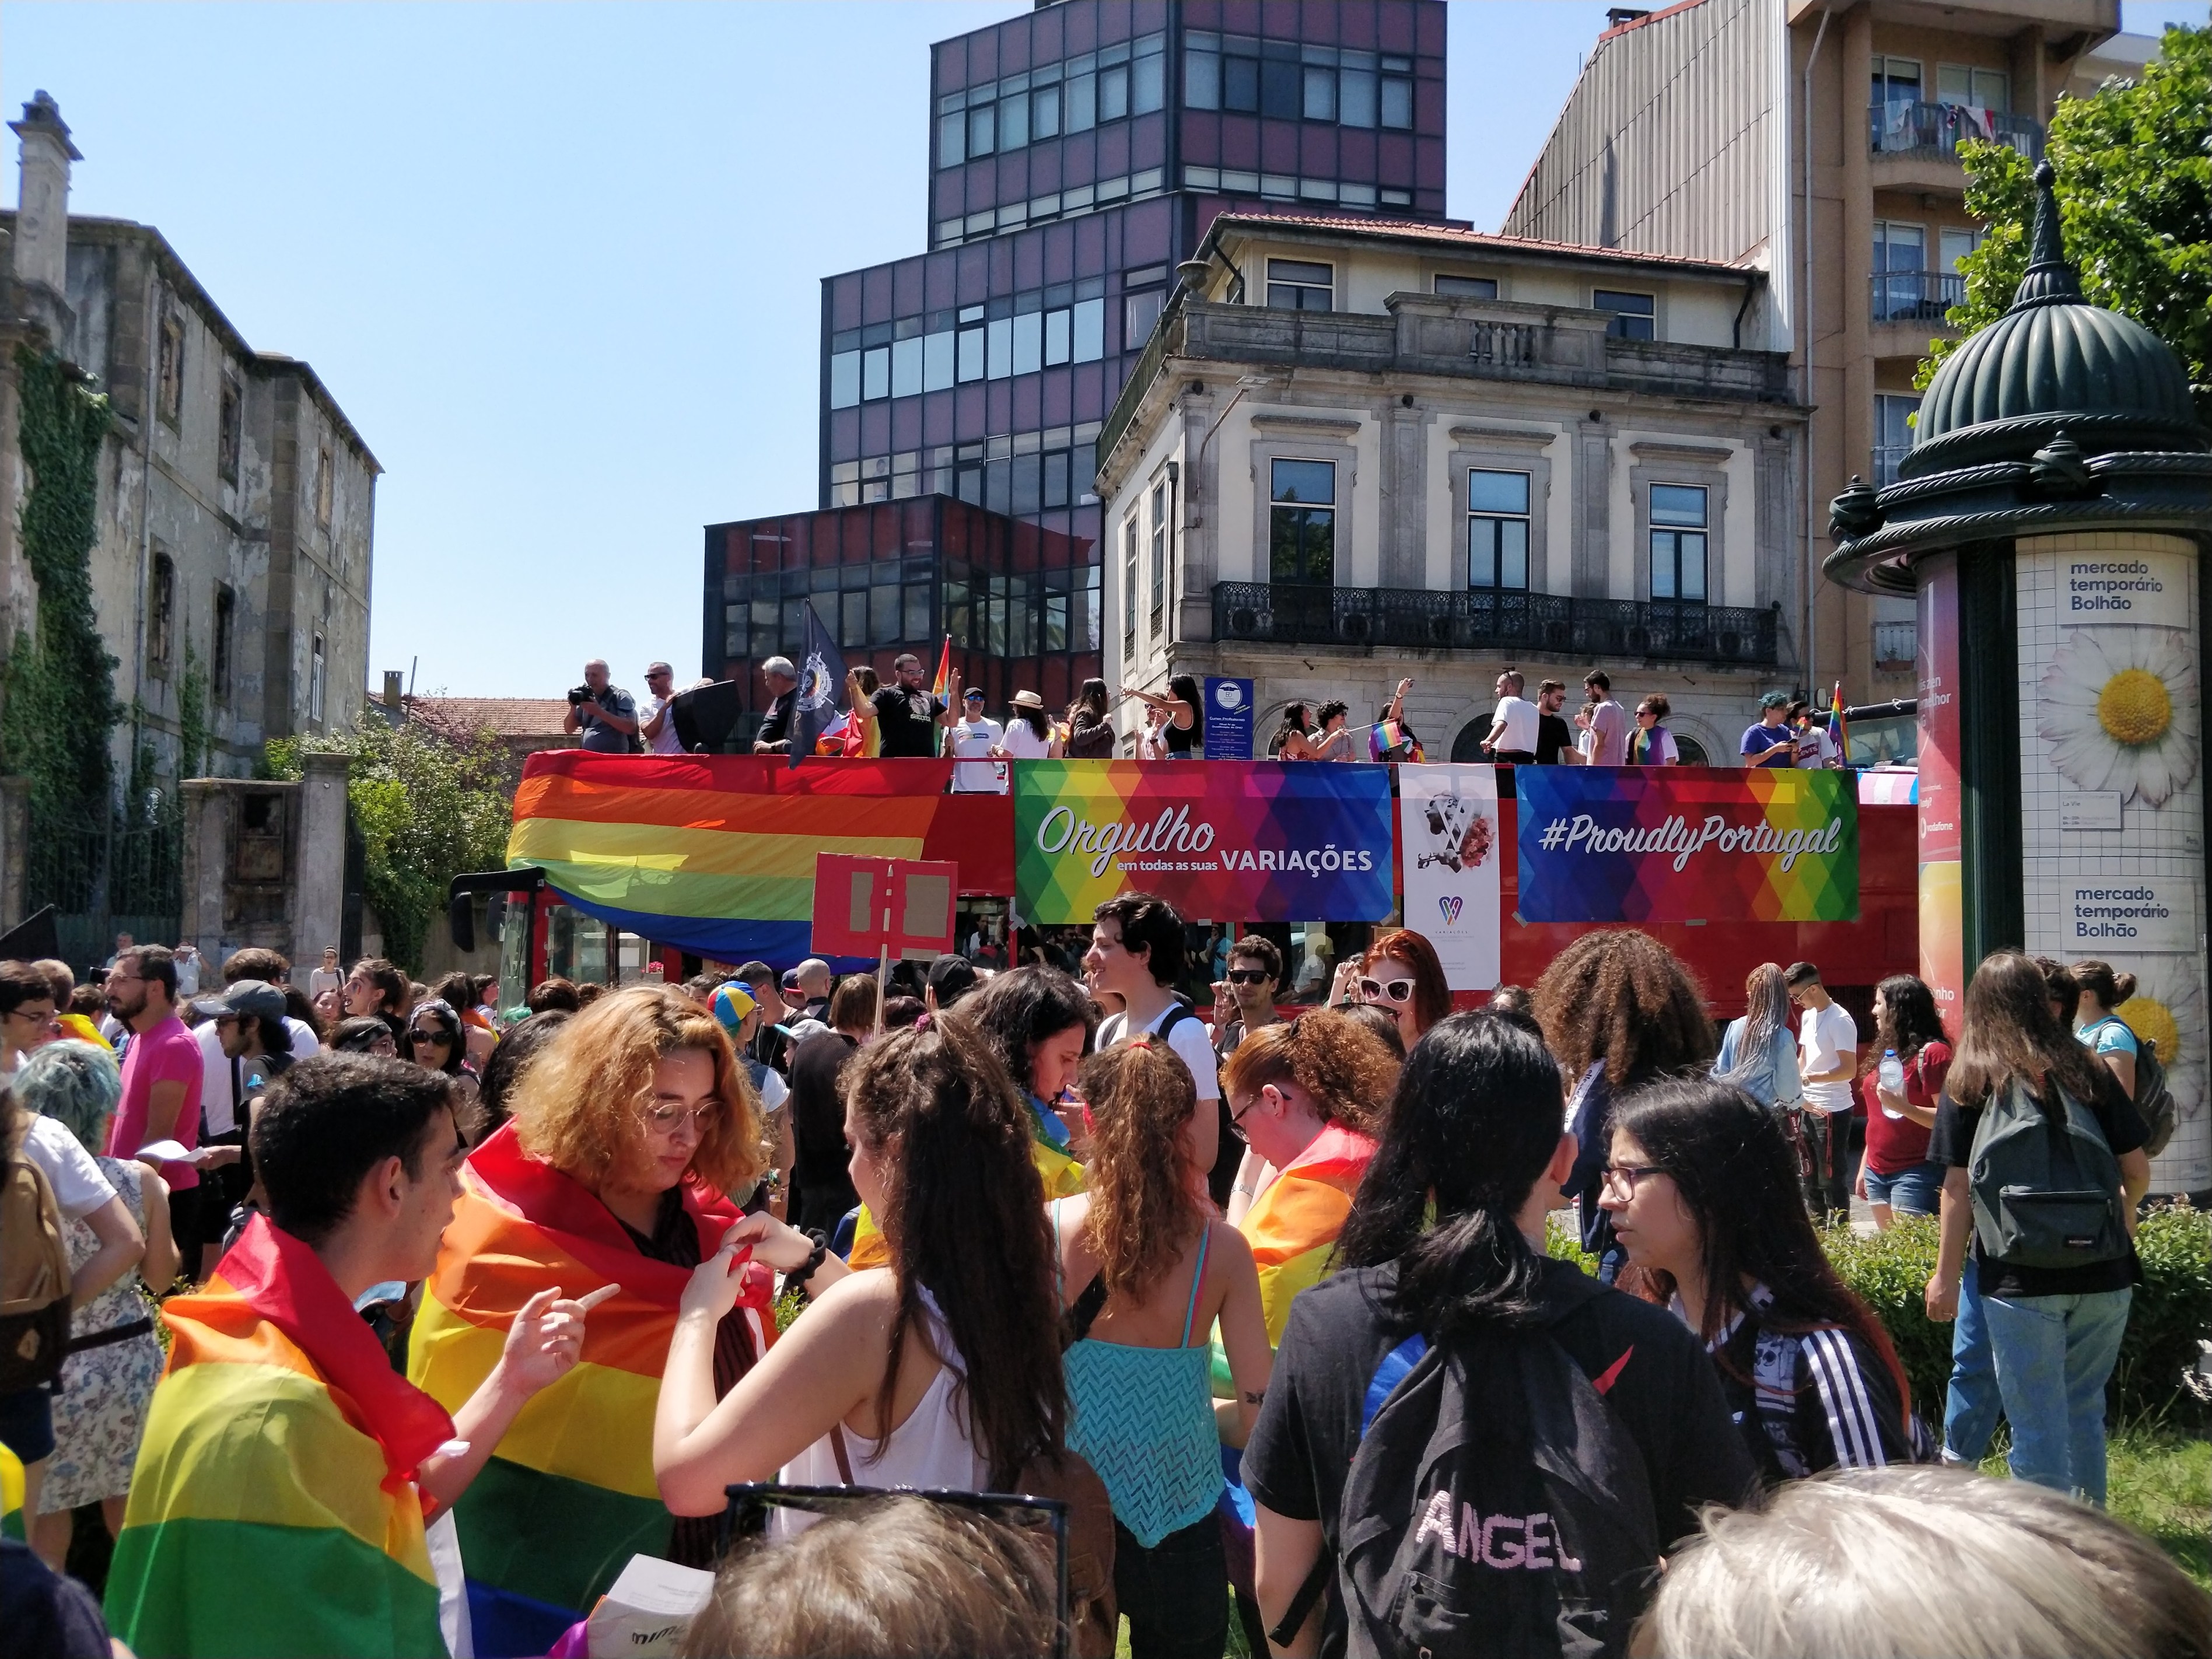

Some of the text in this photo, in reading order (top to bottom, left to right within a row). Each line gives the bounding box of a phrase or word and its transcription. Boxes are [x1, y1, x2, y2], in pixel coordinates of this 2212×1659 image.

[2070, 560, 2149, 576] mercado
[2070, 577, 2164, 593] temporário
[2071, 596, 2133, 611] Bolhão
[1927, 821, 1953, 832] vodafone
[1038, 804, 1216, 878] Orgulho
[1538, 814, 1841, 873] #ProudlyPortugal
[1116, 845, 1373, 878] em todas as suas VARIAÇÕES
[2075, 886, 2154, 901] mercado
[2074, 902, 2169, 920] temporário
[2076, 922, 2138, 938] Bolhão
[1416, 1490, 1582, 1572] ANGEL
